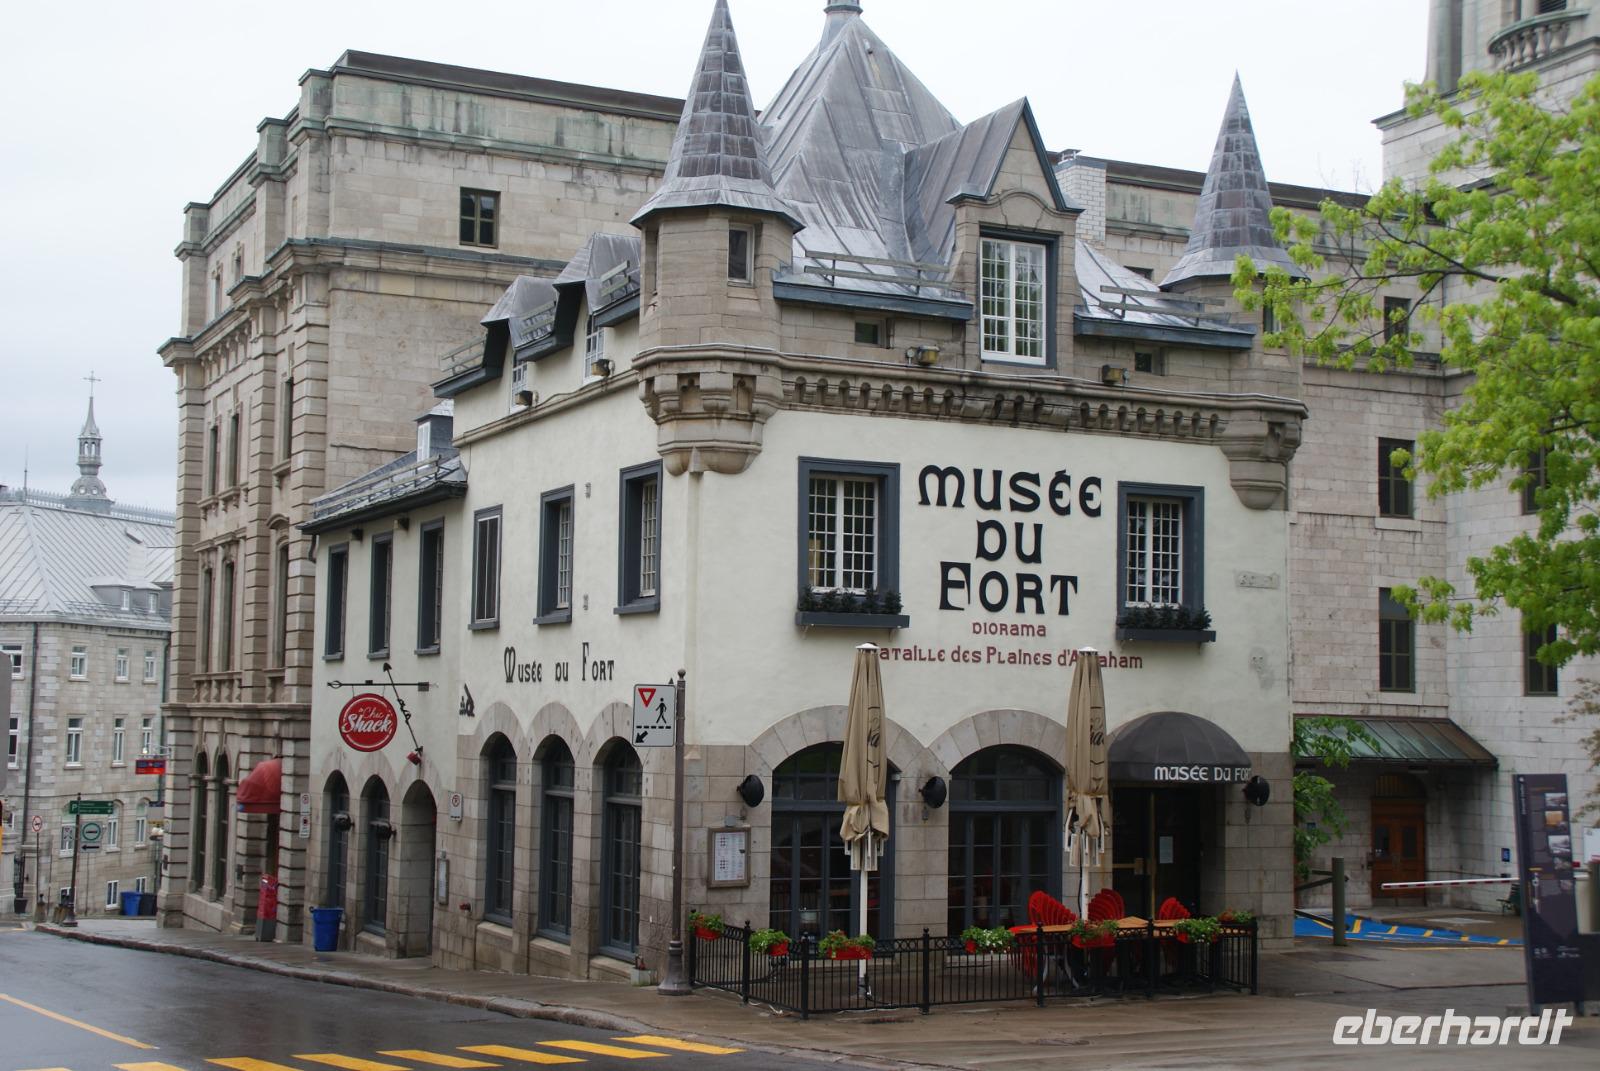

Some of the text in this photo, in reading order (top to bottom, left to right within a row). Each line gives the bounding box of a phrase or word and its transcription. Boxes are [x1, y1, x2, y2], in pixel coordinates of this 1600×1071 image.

[975, 519, 1043, 564] DU
[939, 561, 1078, 615] FORT
[880, 645, 1143, 669] ataille des Plaines d'Aaham
[341, 713, 393, 733] Shack
